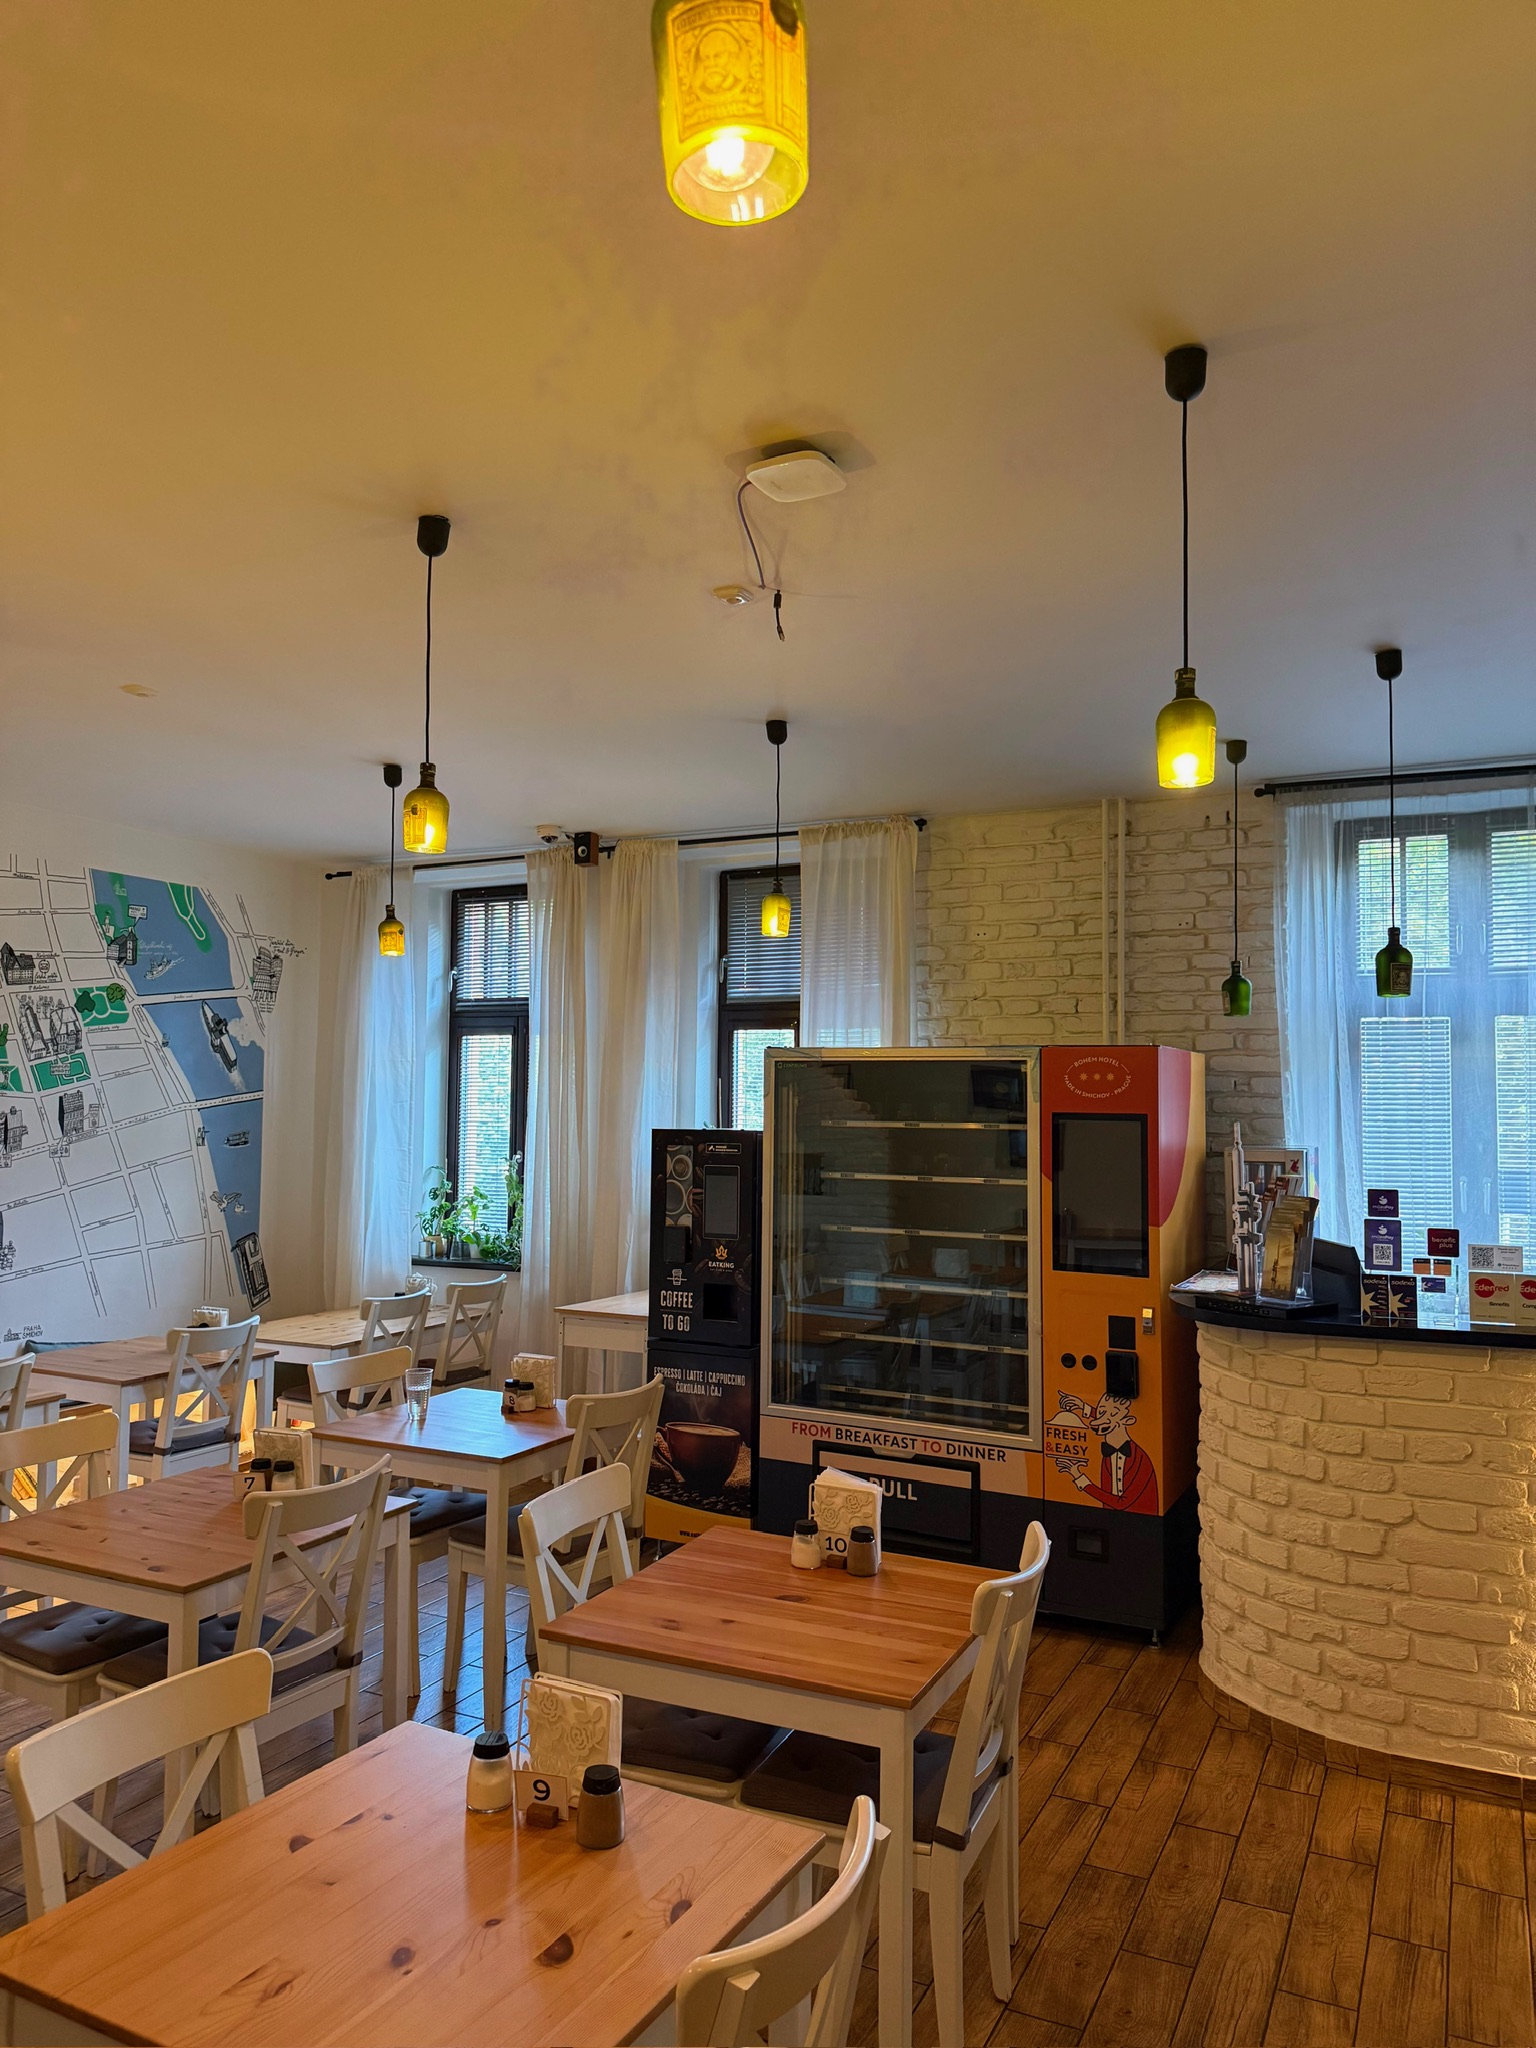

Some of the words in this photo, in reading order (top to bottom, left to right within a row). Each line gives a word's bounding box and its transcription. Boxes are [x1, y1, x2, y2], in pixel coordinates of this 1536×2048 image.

[1074, 1057, 1097, 1067] BOHEM
[1099, 1057, 1119, 1067] HOTEL
[1064, 1075, 1075, 1091] MADE
[1114, 1075, 1131, 1095] PRAGUE
[708, 1261, 735, 1269] EATKING
[1474, 1283, 1510, 1292] Edenred
[660, 1290, 694, 1308] COFFEE
[662, 1314, 674, 1330] TO
[677, 1315, 690, 1332] GO
[654, 1366, 681, 1380] ESPRESSO
[686, 1369, 704, 1382] LATTE
[708, 1372, 746, 1387] CAPPUCCINO
[509, 1395, 516, 1405] 8
[791, 1421, 831, 1439] FROM
[835, 1430, 918, 1451] BREAKFAST
[921, 1439, 942, 1454] TO
[946, 1443, 1006, 1462] DINNER
[1046, 1427, 1087, 1442] FRESH
[244, 1477, 255, 1490] 7
[825, 1536, 848, 1553] 10
[532, 1779, 550, 1801] 9
